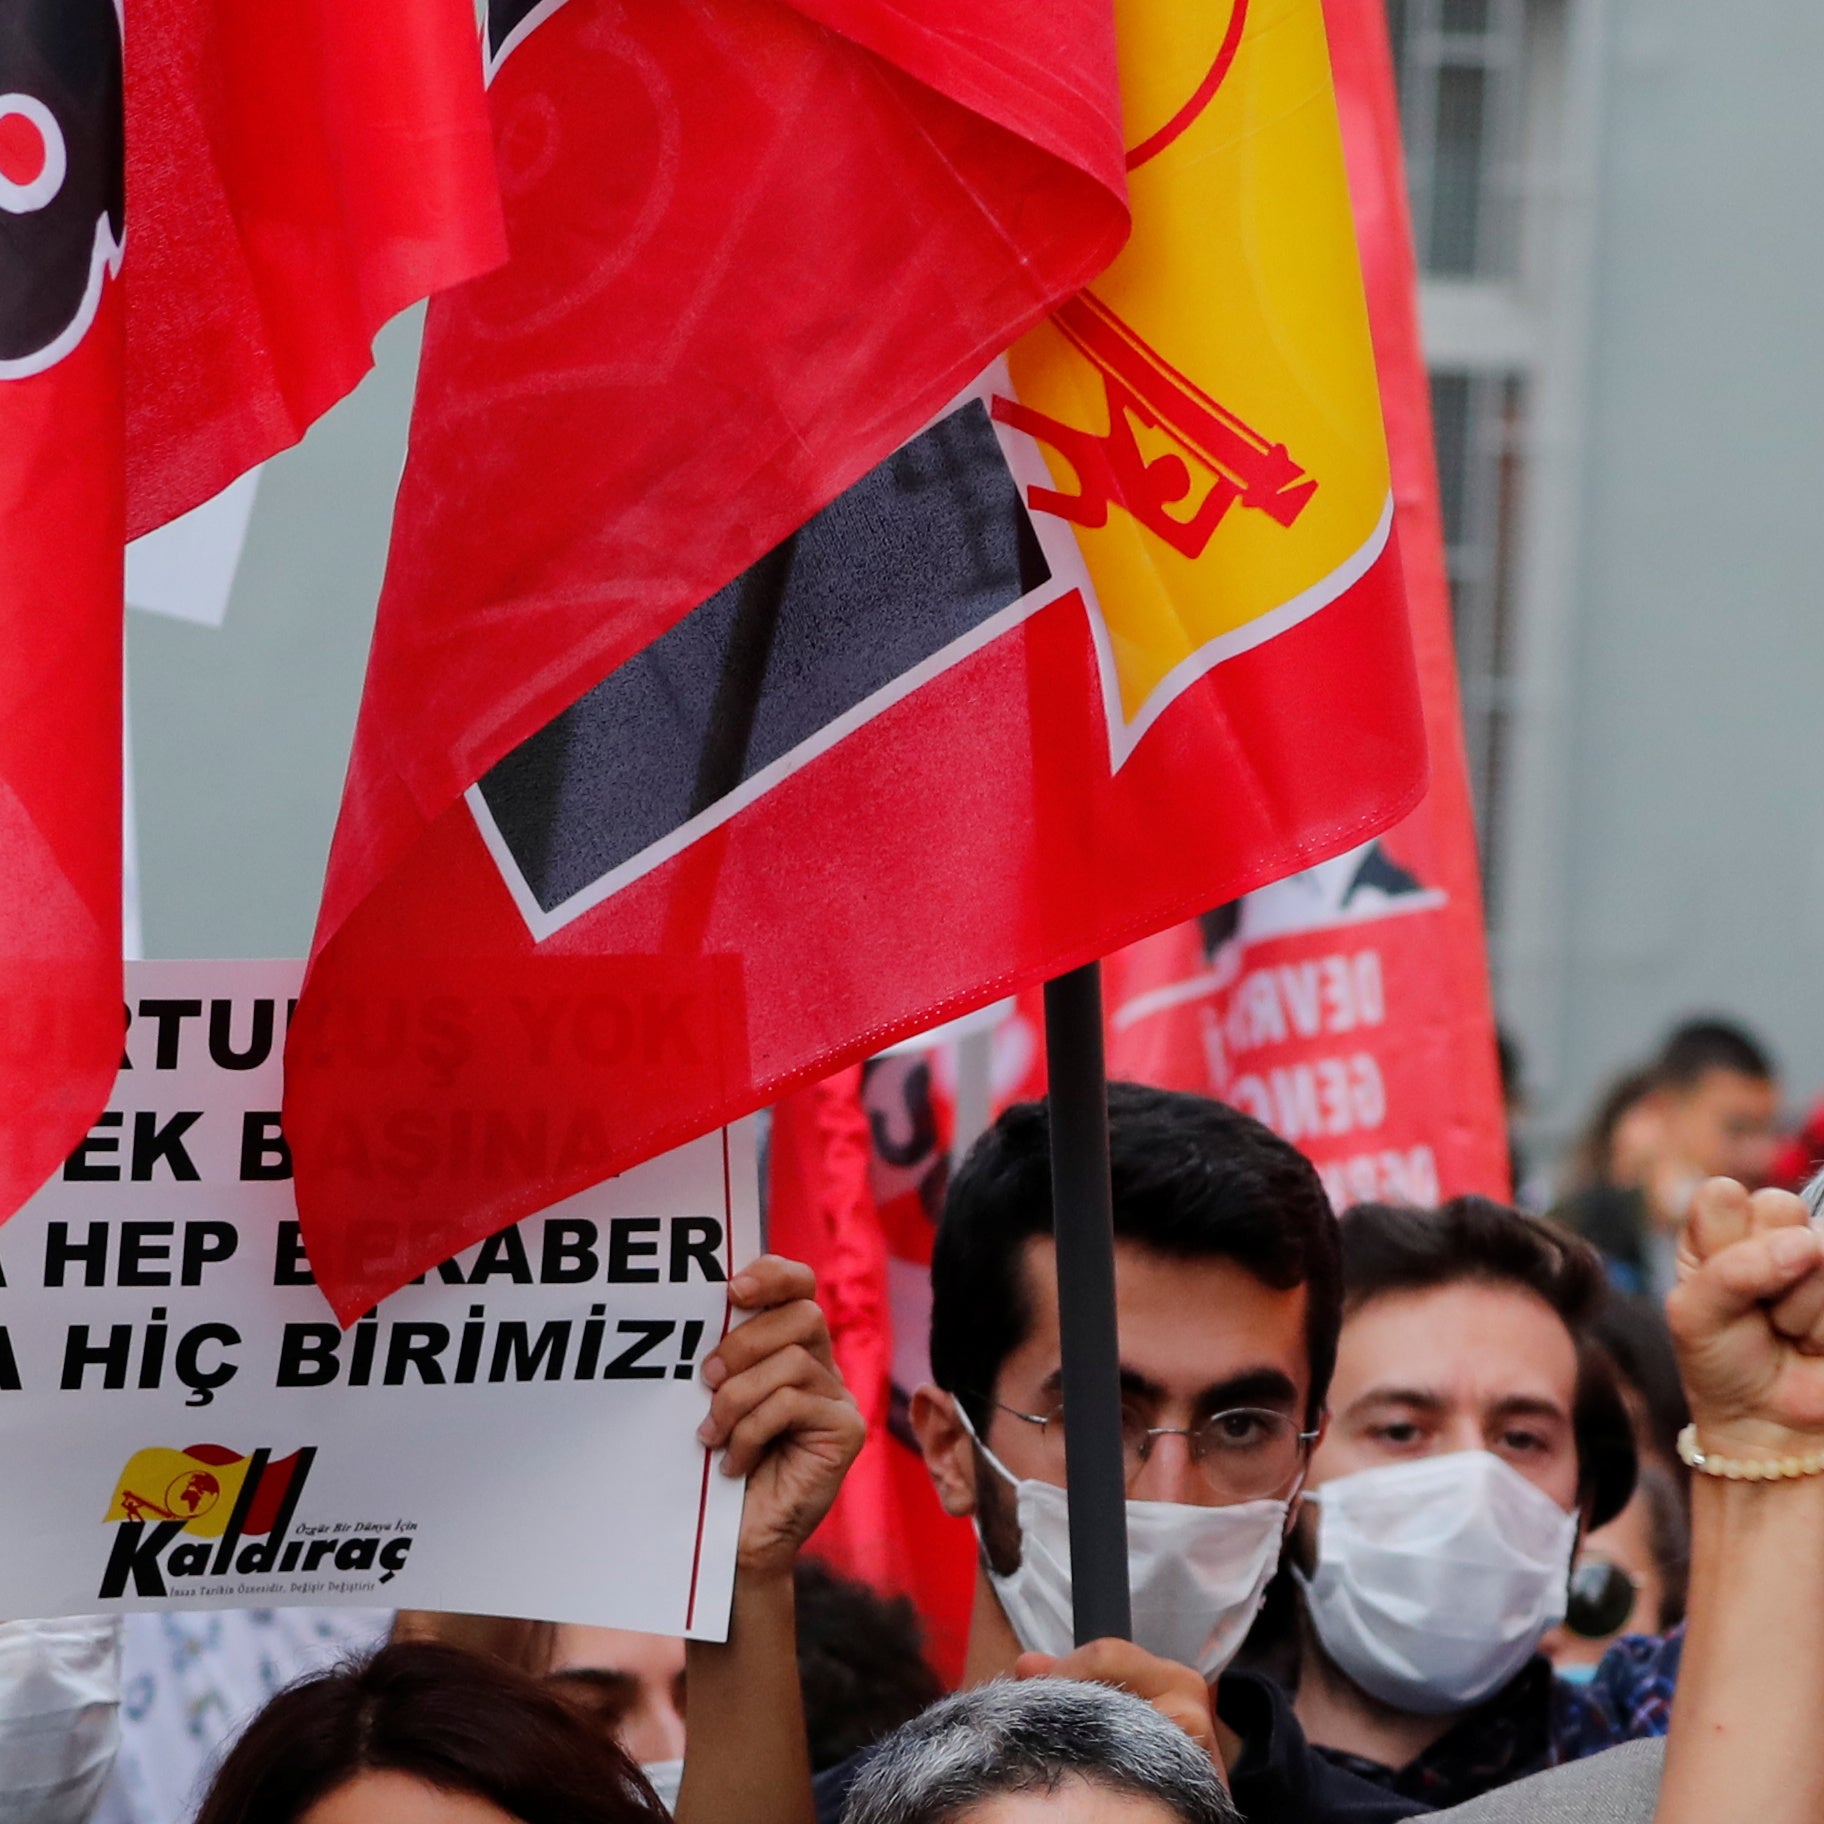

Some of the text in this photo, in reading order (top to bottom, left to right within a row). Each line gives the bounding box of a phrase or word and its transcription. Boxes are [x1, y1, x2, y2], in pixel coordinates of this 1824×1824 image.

[43, 1220, 239, 1288] HEP
[59, 1306, 242, 1407] HİÇ
[275, 1302, 706, 1389] BİRİMİZ!
[97, 1445, 413, 1600] Kaldıraç
